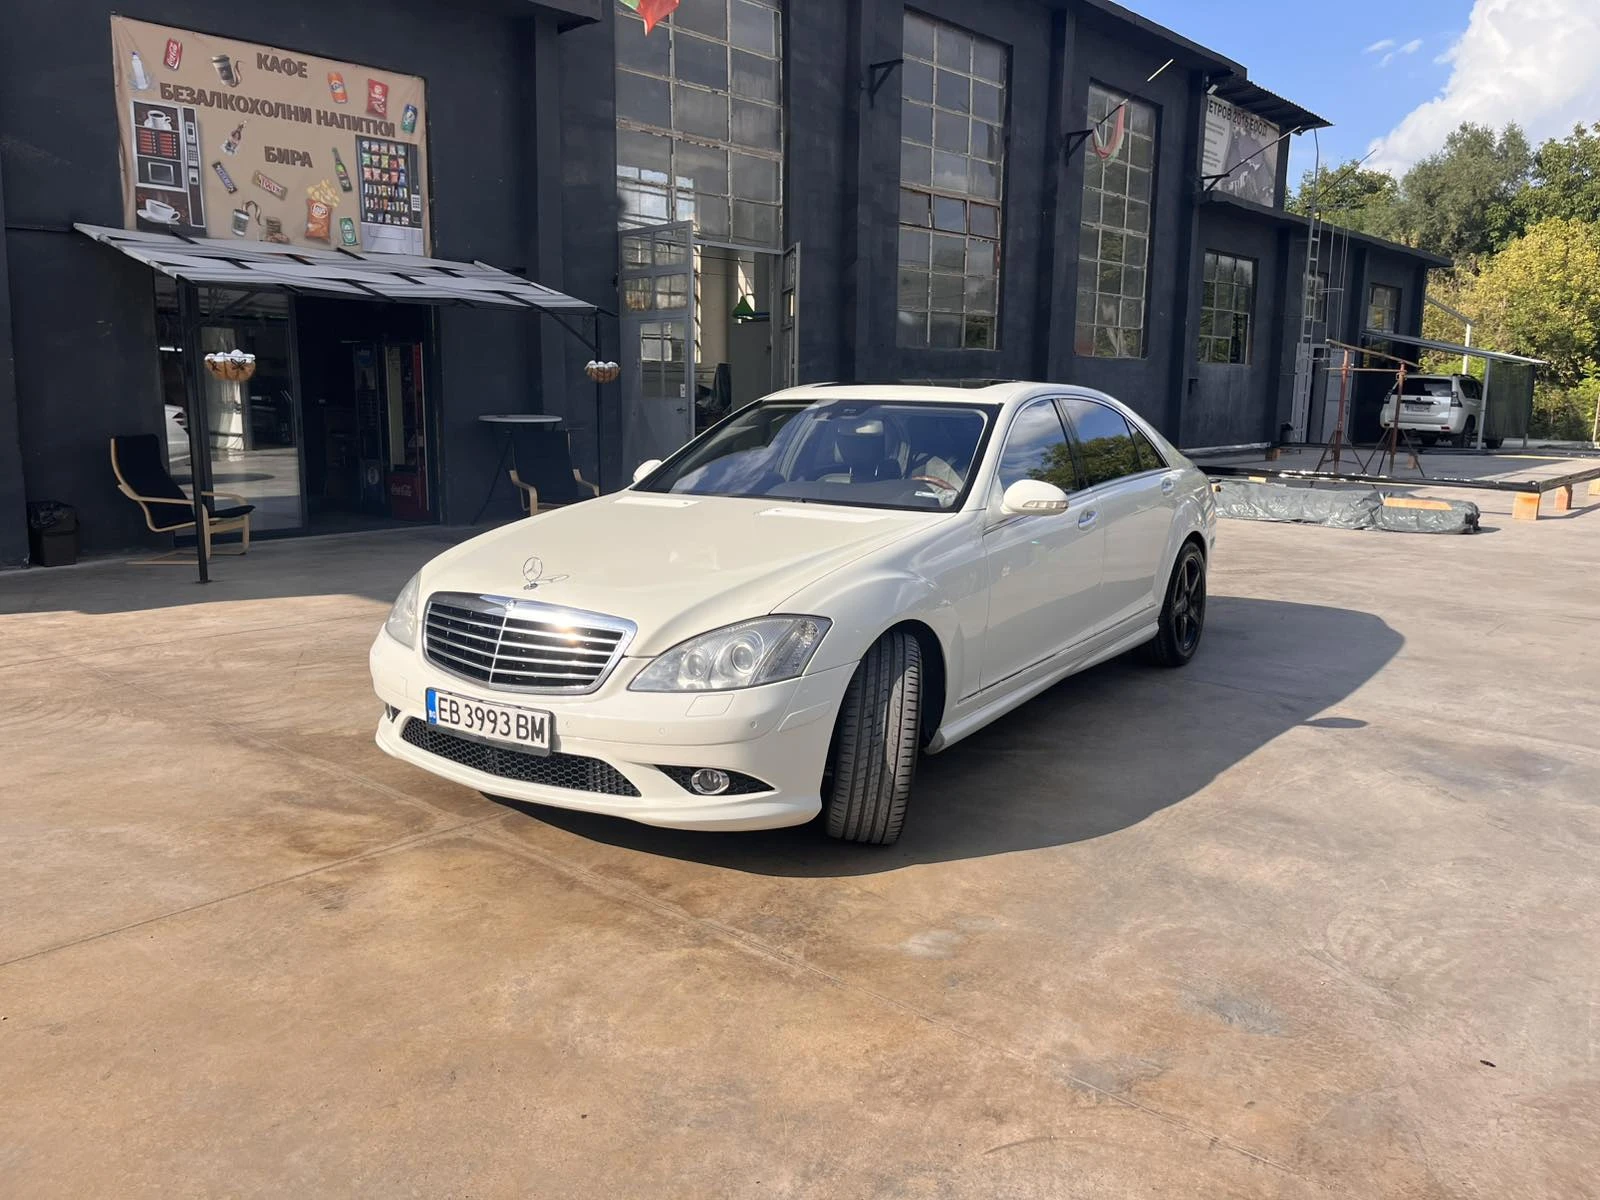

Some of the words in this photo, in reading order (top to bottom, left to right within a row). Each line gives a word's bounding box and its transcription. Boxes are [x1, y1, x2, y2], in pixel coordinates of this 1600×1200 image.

[256, 53, 308, 78] КАФЕ
[160, 82, 312, 124] БЕЗАЛКОХОЛНИ
[316, 109, 396, 138] НАПИТКИ
[1208, 101, 1231, 120] ЕТРОВ
[264, 146, 313, 168] БИРА
[438, 697, 460, 725] EB
[464, 704, 511, 736] 3993
[516, 714, 545, 744] BM
